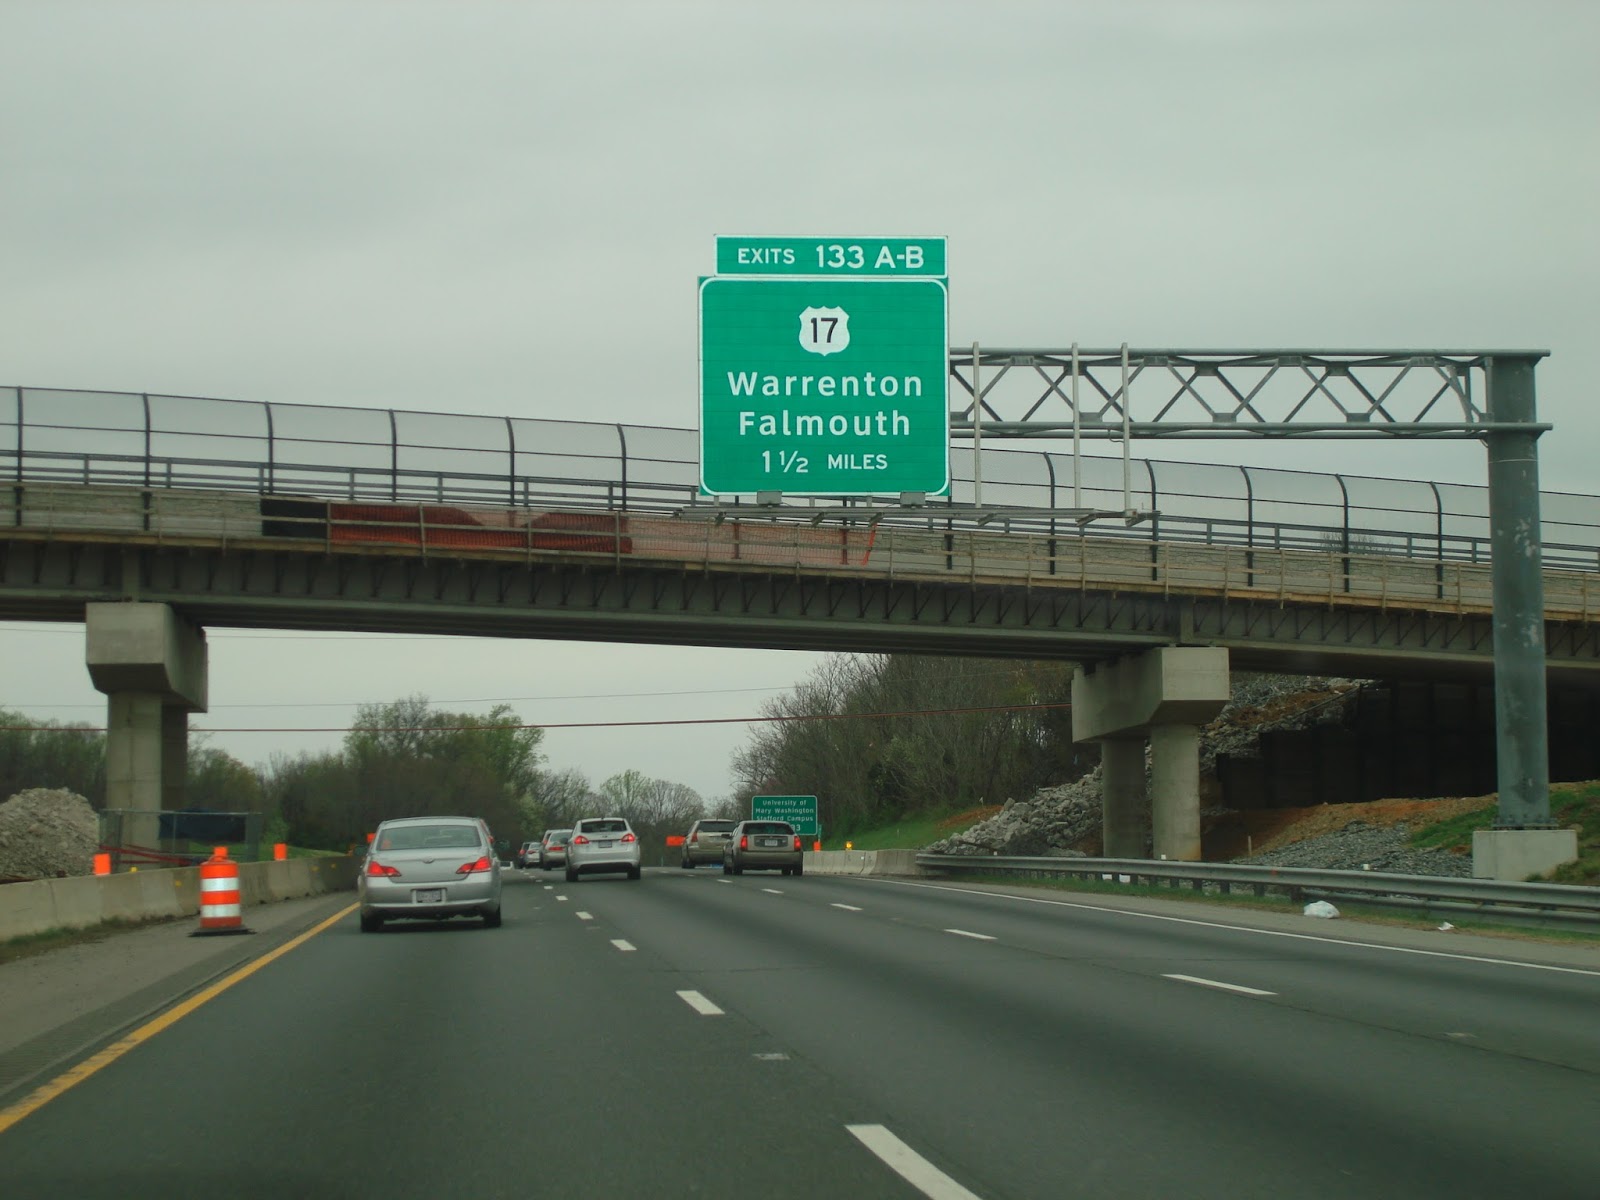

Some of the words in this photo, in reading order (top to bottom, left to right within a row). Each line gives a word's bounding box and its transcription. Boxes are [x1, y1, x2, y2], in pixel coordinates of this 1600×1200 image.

[737, 247, 796, 265] EXITS
[815, 245, 865, 268] 133
[874, 245, 924, 269] A-B
[810, 317, 839, 343] 17
[727, 371, 922, 397] Warrenton
[739, 409, 910, 436] Falmouth
[827, 454, 888, 470] MILES
